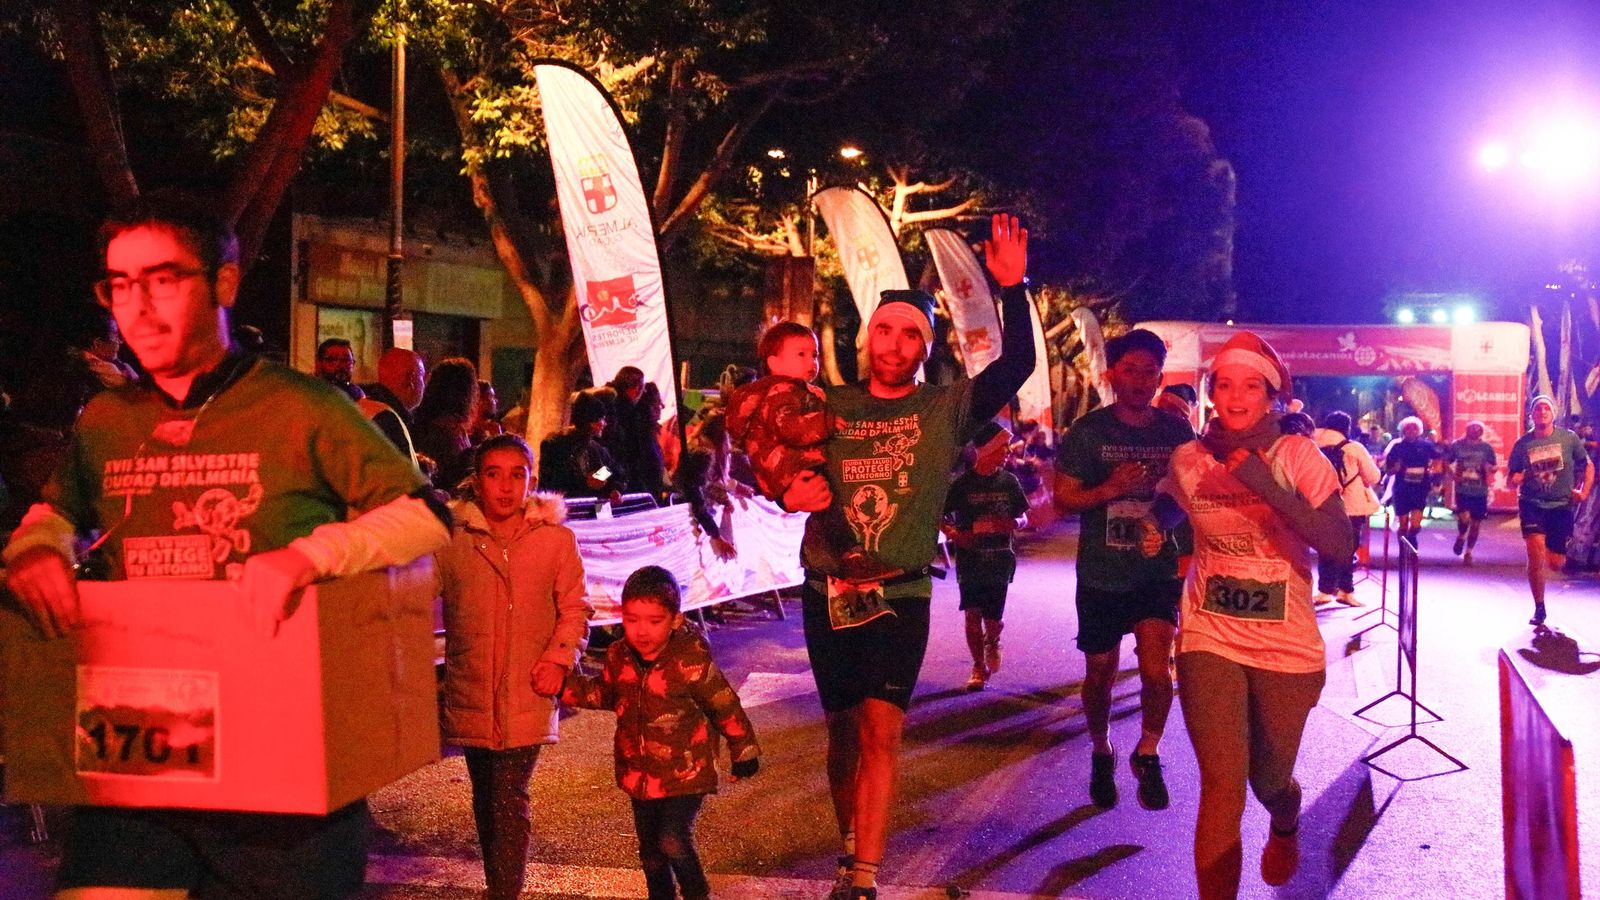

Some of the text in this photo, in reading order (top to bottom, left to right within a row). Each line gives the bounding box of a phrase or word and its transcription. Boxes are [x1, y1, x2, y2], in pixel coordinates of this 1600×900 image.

[856, 420, 874, 429] SAN
[135, 455, 169, 472] SAN
[171, 453, 260, 470] SILVESTRE
[845, 464, 890, 474] PROTEGE
[159, 471, 181, 487] DE
[856, 471, 890, 479] ENTORNO
[127, 548, 208, 564] PROTEGE
[1216, 586, 1269, 612] 302
